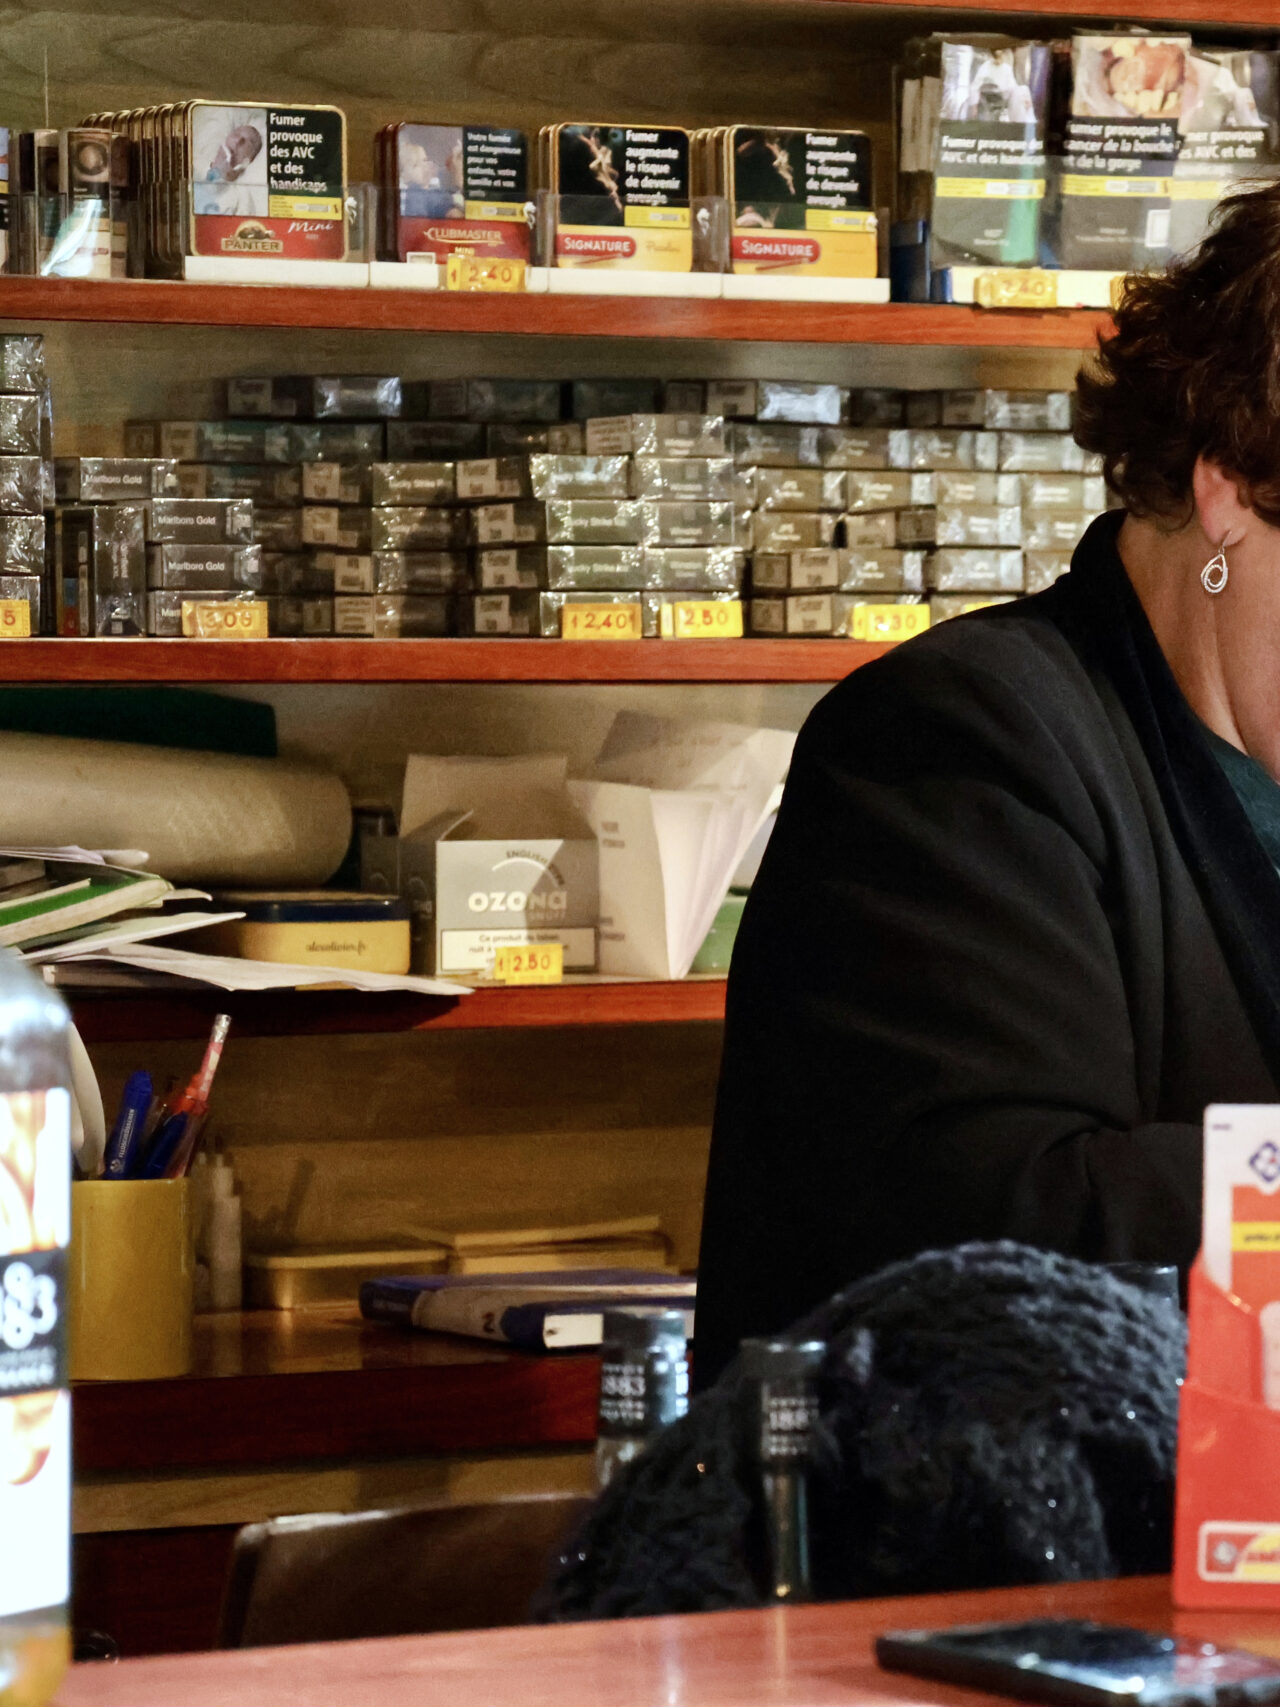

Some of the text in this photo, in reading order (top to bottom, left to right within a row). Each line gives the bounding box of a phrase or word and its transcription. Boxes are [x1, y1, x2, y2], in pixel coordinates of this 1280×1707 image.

[270, 113, 305, 127] Fumer
[467, 132, 487, 142] Votre
[626, 130, 660, 143] Fumer
[1104, 125, 1160, 138] provoque
[1160, 123, 1171, 136] le
[270, 131, 323, 145] provoque
[806, 133, 838, 146] Fumer
[942, 136, 977, 148] Fumer
[978, 139, 1027, 152] provoque
[1210, 131, 1264, 144] provoque
[270, 145, 315, 159] des AVC
[467, 144, 479, 152] est
[1104, 139, 1118, 152] de
[1120, 139, 1131, 151] la
[1133, 139, 1174, 152] bouche
[1194, 145, 1256, 158] AVC et des
[626, 147, 680, 160] augmente
[806, 150, 858, 164] augmente
[966, 153, 977, 163] et
[979, 152, 998, 164] des
[270, 161, 304, 174] et des
[626, 160, 671, 175] le risque
[1076, 155, 1142, 172] de la gorge
[806, 163, 849, 179] le risque
[270, 177, 328, 194] handicaps
[625, 175, 681, 189] de devenir
[806, 177, 859, 192] de devenir
[626, 191, 668, 206] aveugle
[424, 228, 502, 241] CLUBMASTER
[224, 240, 282, 251] PANTER
[455, 246, 475, 257] MINI
[564, 237, 631, 253] SIGNATURE
[741, 240, 814, 257] SIGNATURE
[86, 474, 142, 484] Marlboro Gold
[158, 515, 216, 525] Marlboro Gold
[168, 561, 225, 572] Marlboro Gold
[479, 934, 491, 943] Ce
[493, 933, 522, 944] produit
